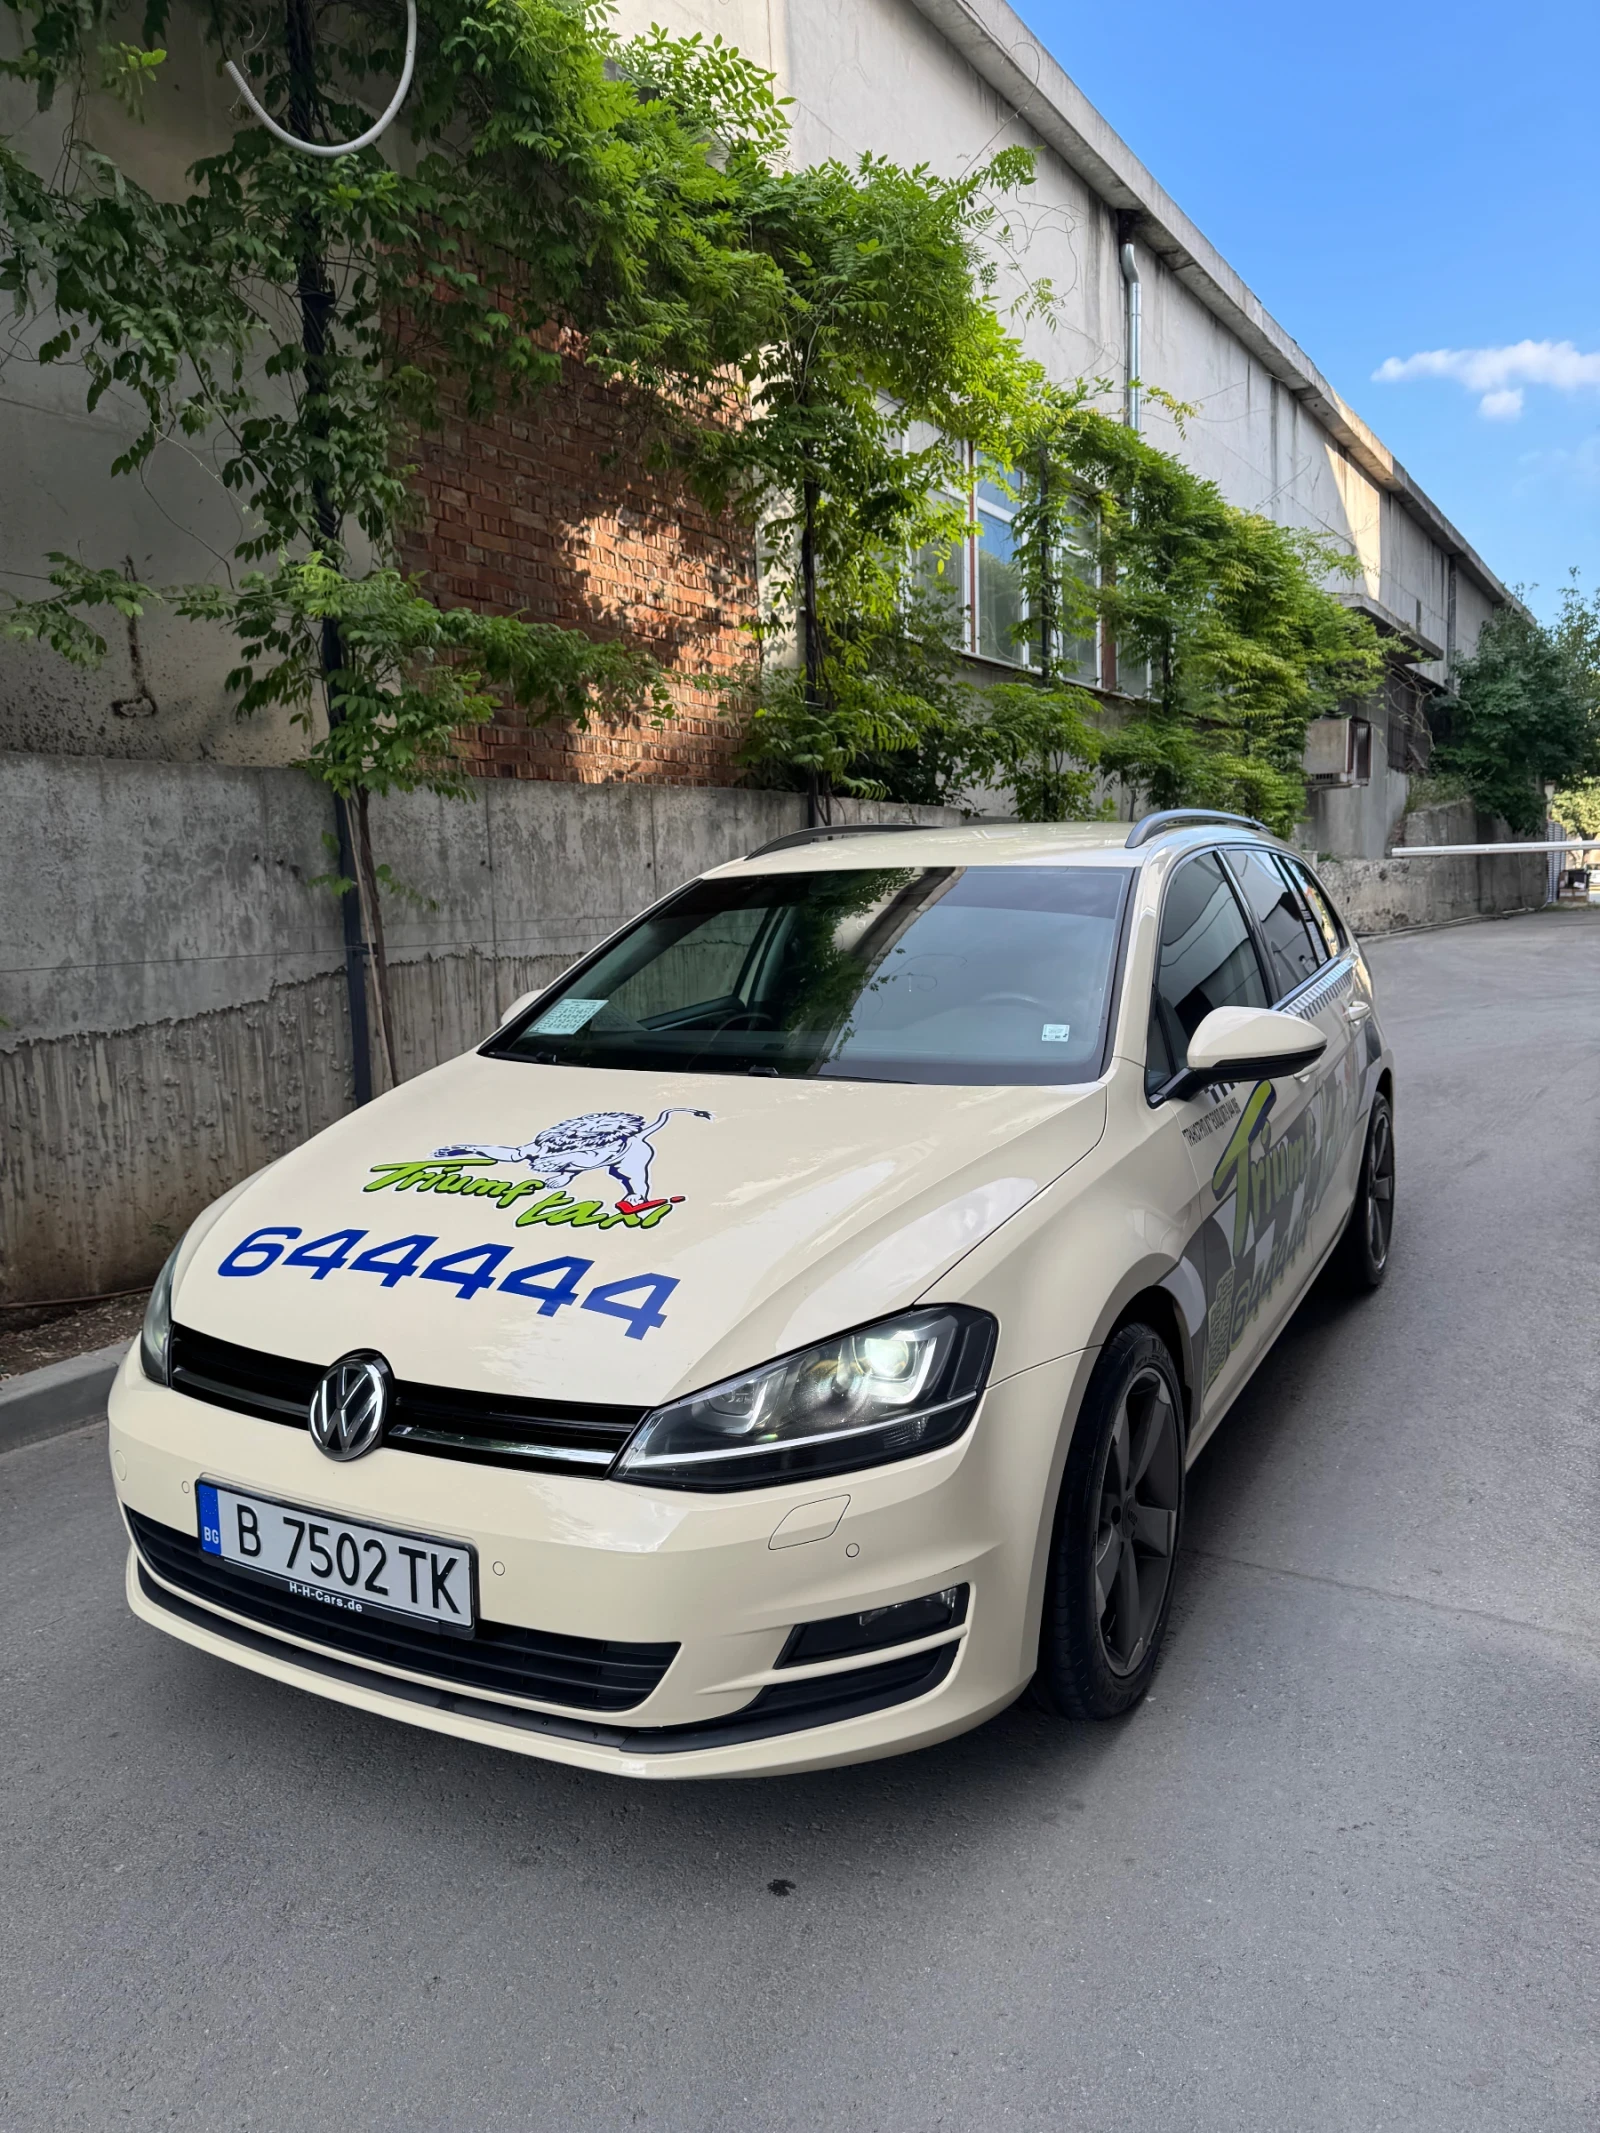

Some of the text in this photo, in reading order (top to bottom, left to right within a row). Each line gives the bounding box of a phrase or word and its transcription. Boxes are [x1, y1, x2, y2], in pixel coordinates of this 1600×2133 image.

[362, 1158, 686, 1229] Triumf taxi
[1212, 1079, 1316, 1257] Triumf
[217, 1226, 682, 1341] 644444
[204, 1526, 219, 1545] BG
[236, 1503, 460, 1615] B 7502 TK
[289, 1582, 363, 1614] H-H-Cars.de
